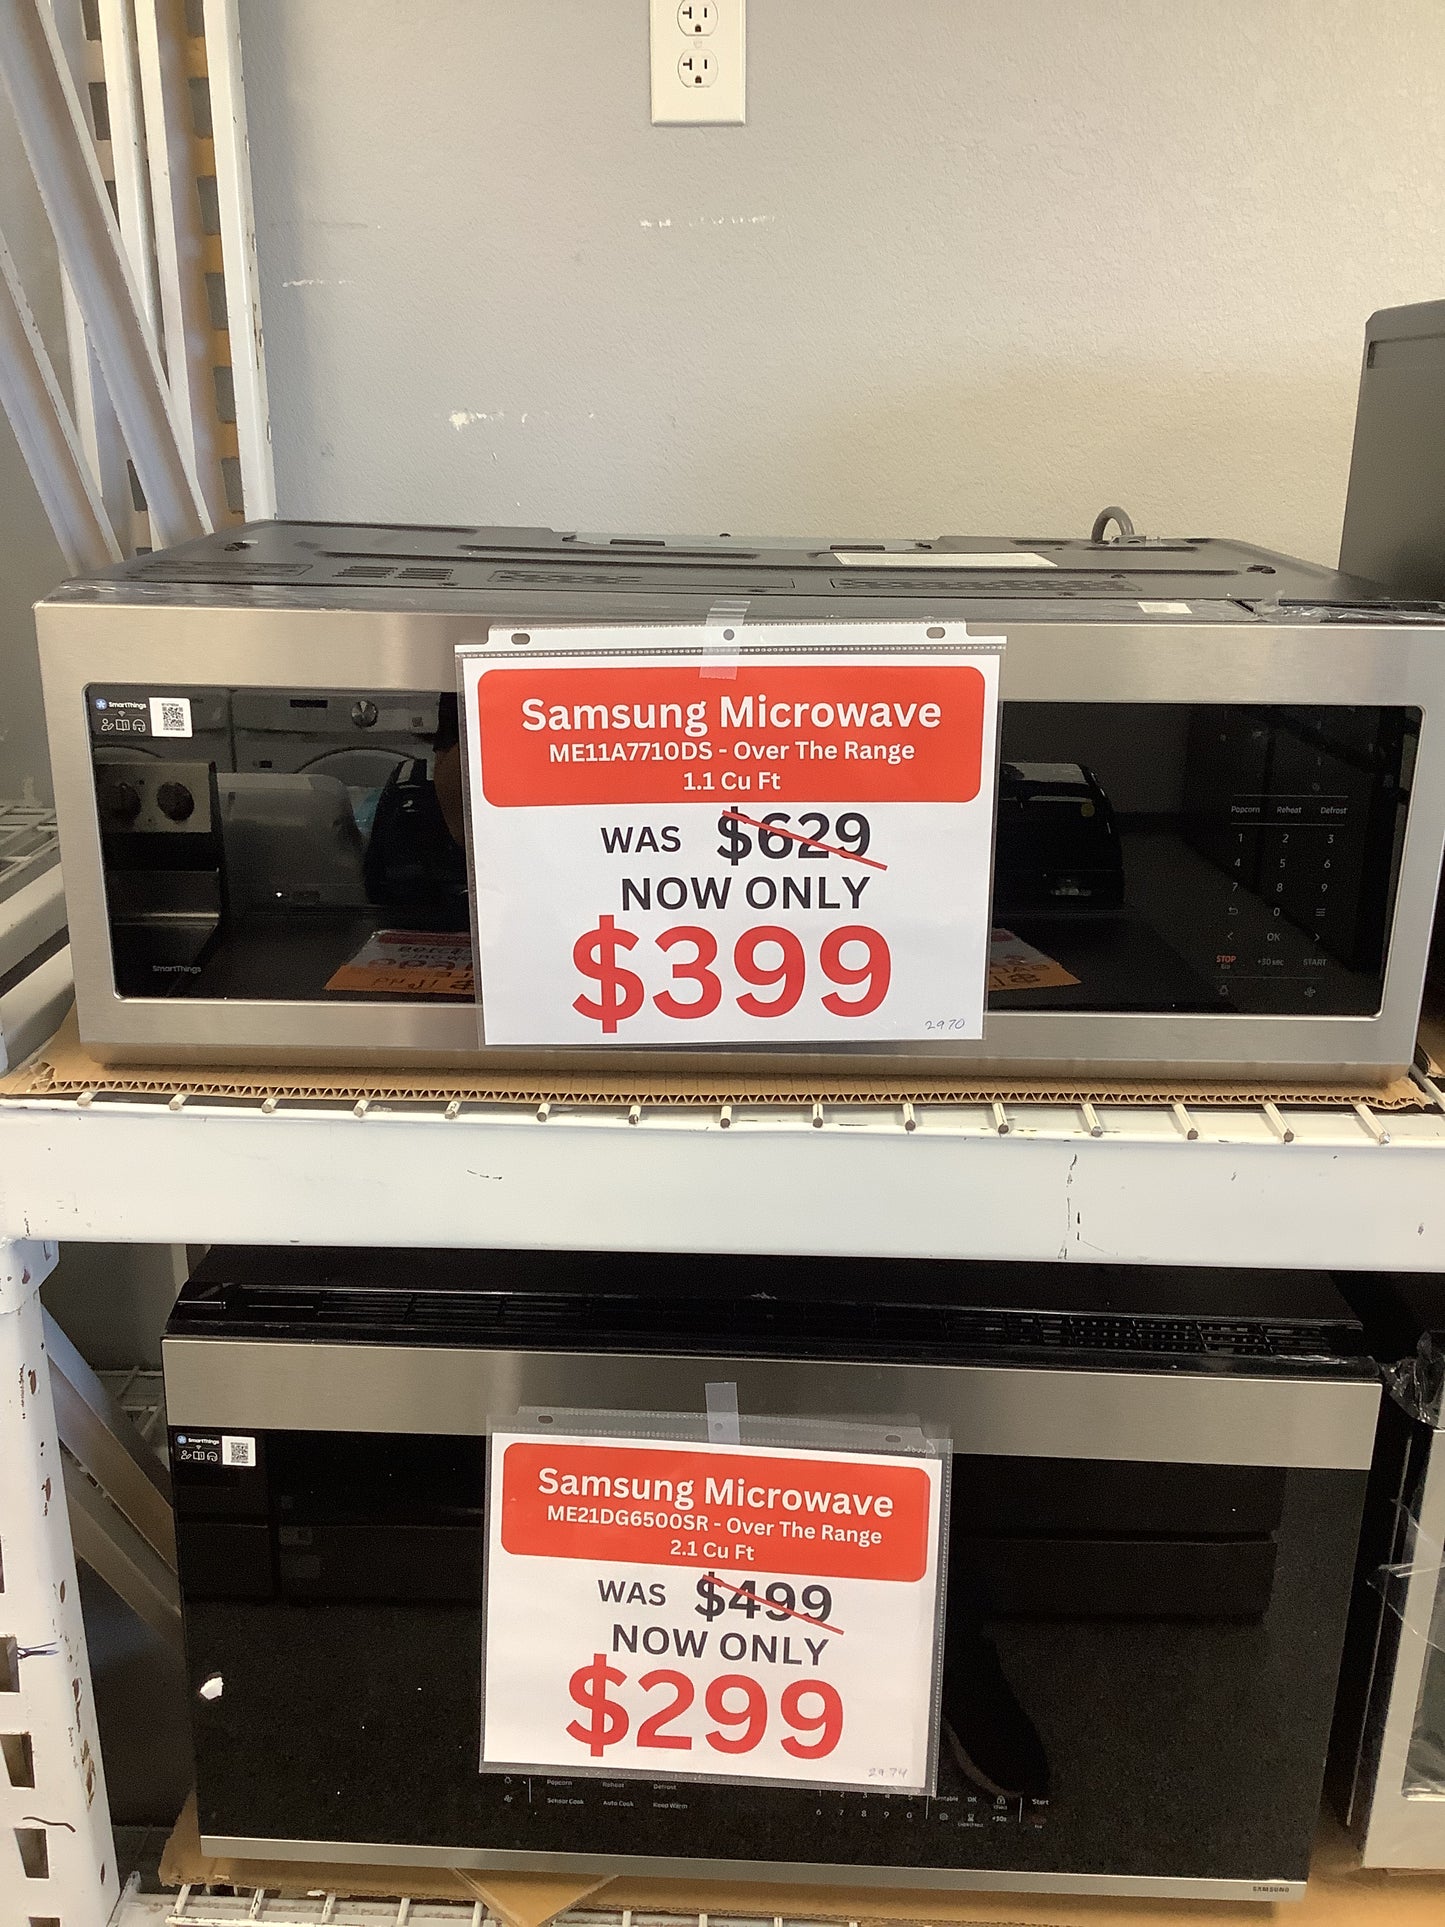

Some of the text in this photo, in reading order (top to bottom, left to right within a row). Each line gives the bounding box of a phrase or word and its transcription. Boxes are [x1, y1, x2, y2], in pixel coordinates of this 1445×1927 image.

[108, 701, 147, 710] SmartThings
[522, 694, 942, 737] Samsung Microwave
[549, 741, 713, 763] ME11A7710DS
[733, 741, 790, 761] Over
[794, 740, 838, 760] The
[844, 741, 915, 765] Range
[683, 771, 781, 791] 1.1 Cu Ft
[1231, 805, 1347, 815] Popcorn Reheat Defrost
[600, 806, 872, 866] WAS $629
[1237, 833, 1334, 844] 1 2 3
[1234, 858, 1331, 869] 4 5 6
[1232, 882, 1328, 893] 7 8 9
[621, 876, 871, 912] NOW ONLY
[1273, 907, 1280, 917] 0
[1267, 932, 1281, 942] OK
[1216, 954, 1237, 963] STOP
[1303, 958, 1328, 966] START
[152, 964, 202, 975] SmartThings
[572, 915, 892, 1034] $399
[924, 1018, 966, 1031] 2970
[188, 1437, 220, 1446] SmartThings
[538, 1467, 894, 1517] Samsung Microwave
[547, 1504, 709, 1532] ME21DG6500SR
[726, 1517, 775, 1536] Over
[779, 1521, 816, 1540] The
[821, 1524, 883, 1545] Range
[670, 1539, 755, 1561] 2.1 Cu Ft
[598, 1571, 833, 1625] WAS $499
[612, 1623, 829, 1666] NOW ONLY
[566, 1653, 844, 1760] $299
[547, 1779, 572, 1787] Popcorn
[816, 1808, 822, 1816] 6
[861, 1809, 867, 1817] 8
[906, 1811, 912, 1819] 0
